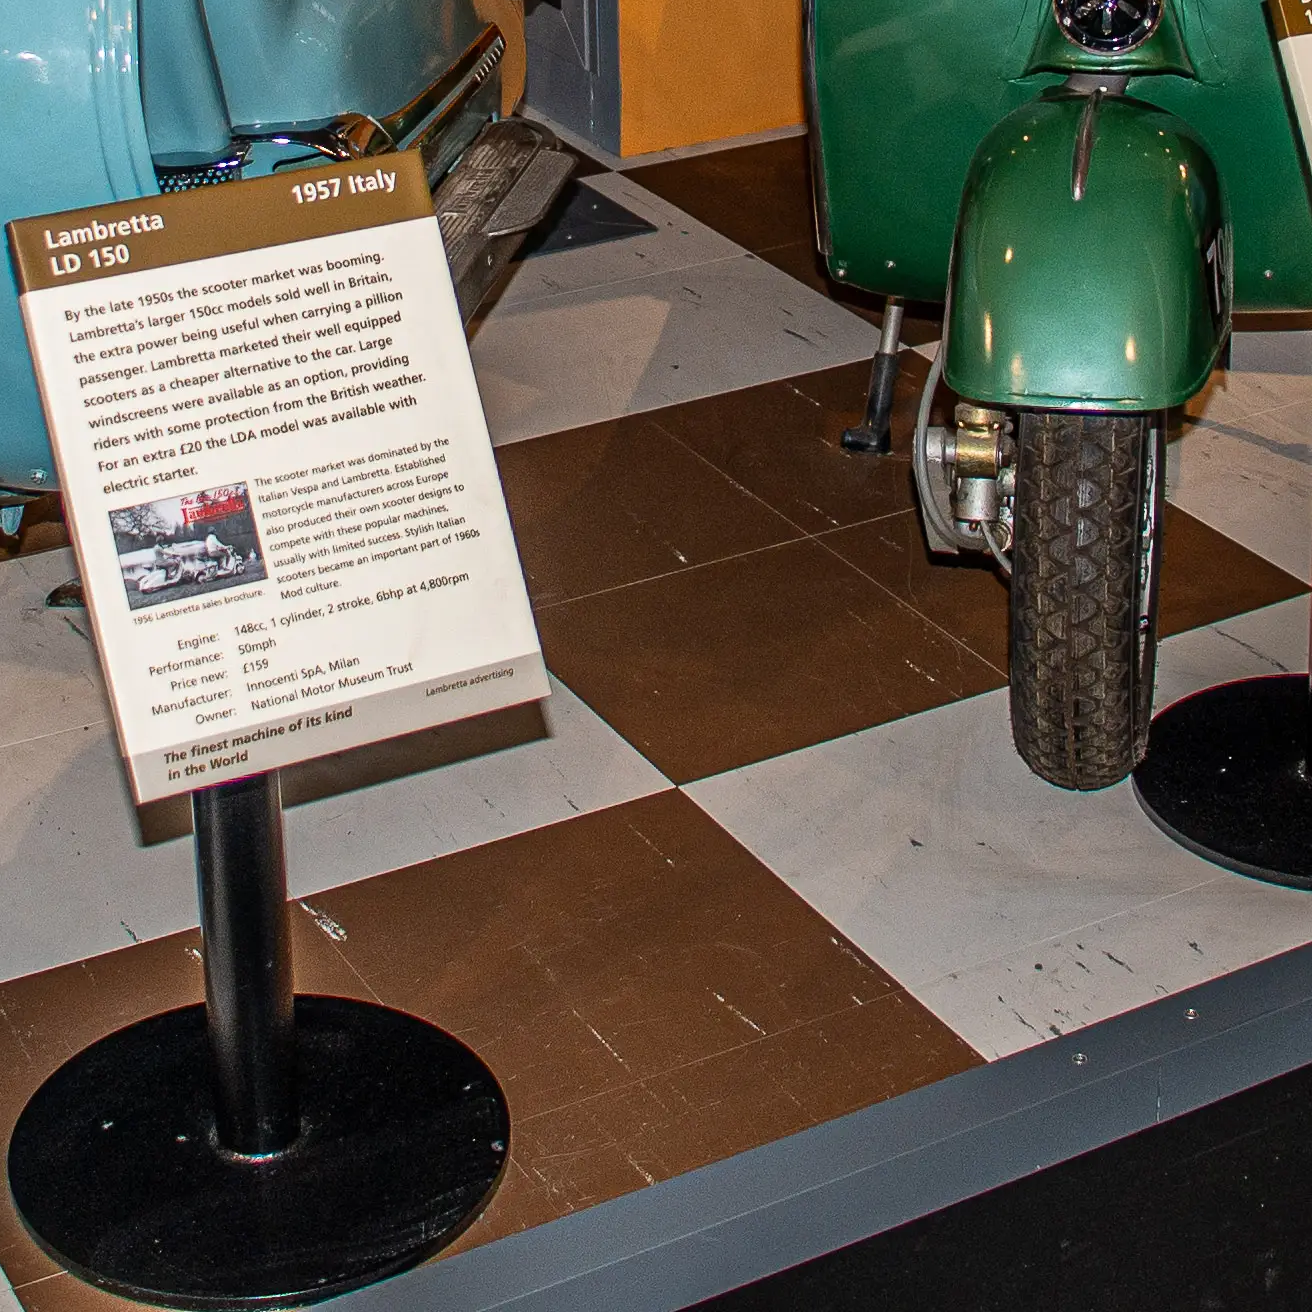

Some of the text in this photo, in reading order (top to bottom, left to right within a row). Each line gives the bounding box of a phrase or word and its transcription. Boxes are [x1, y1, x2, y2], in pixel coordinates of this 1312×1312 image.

[291, 168, 395, 203] 1957 Italy
[43, 213, 164, 249] Lambretta
[49, 243, 129, 276] LD 150
[64, 252, 384, 322] By the late 1950s the scooter market was booming.
[68, 271, 392, 342] Lambretta's larger 150cc models sold well in Britain,
[73, 291, 403, 364] the extra power being useful when carrying a pillion
[78, 310, 401, 388] passenger. Lambretta marketed their well equipped
[83, 336, 392, 407] scooters as a cheaper alternative to the car. Large
[253, 437, 449, 486] The scooter market was dominated by the
[234, 572, 469, 635] 148cc, 1 cylinder, 2 stroke, 6bhp at 4,800rpm
[176, 632, 219, 650] Engine:
[163, 705, 352, 764] The finest machine of its kind
[167, 749, 248, 781] in the World
